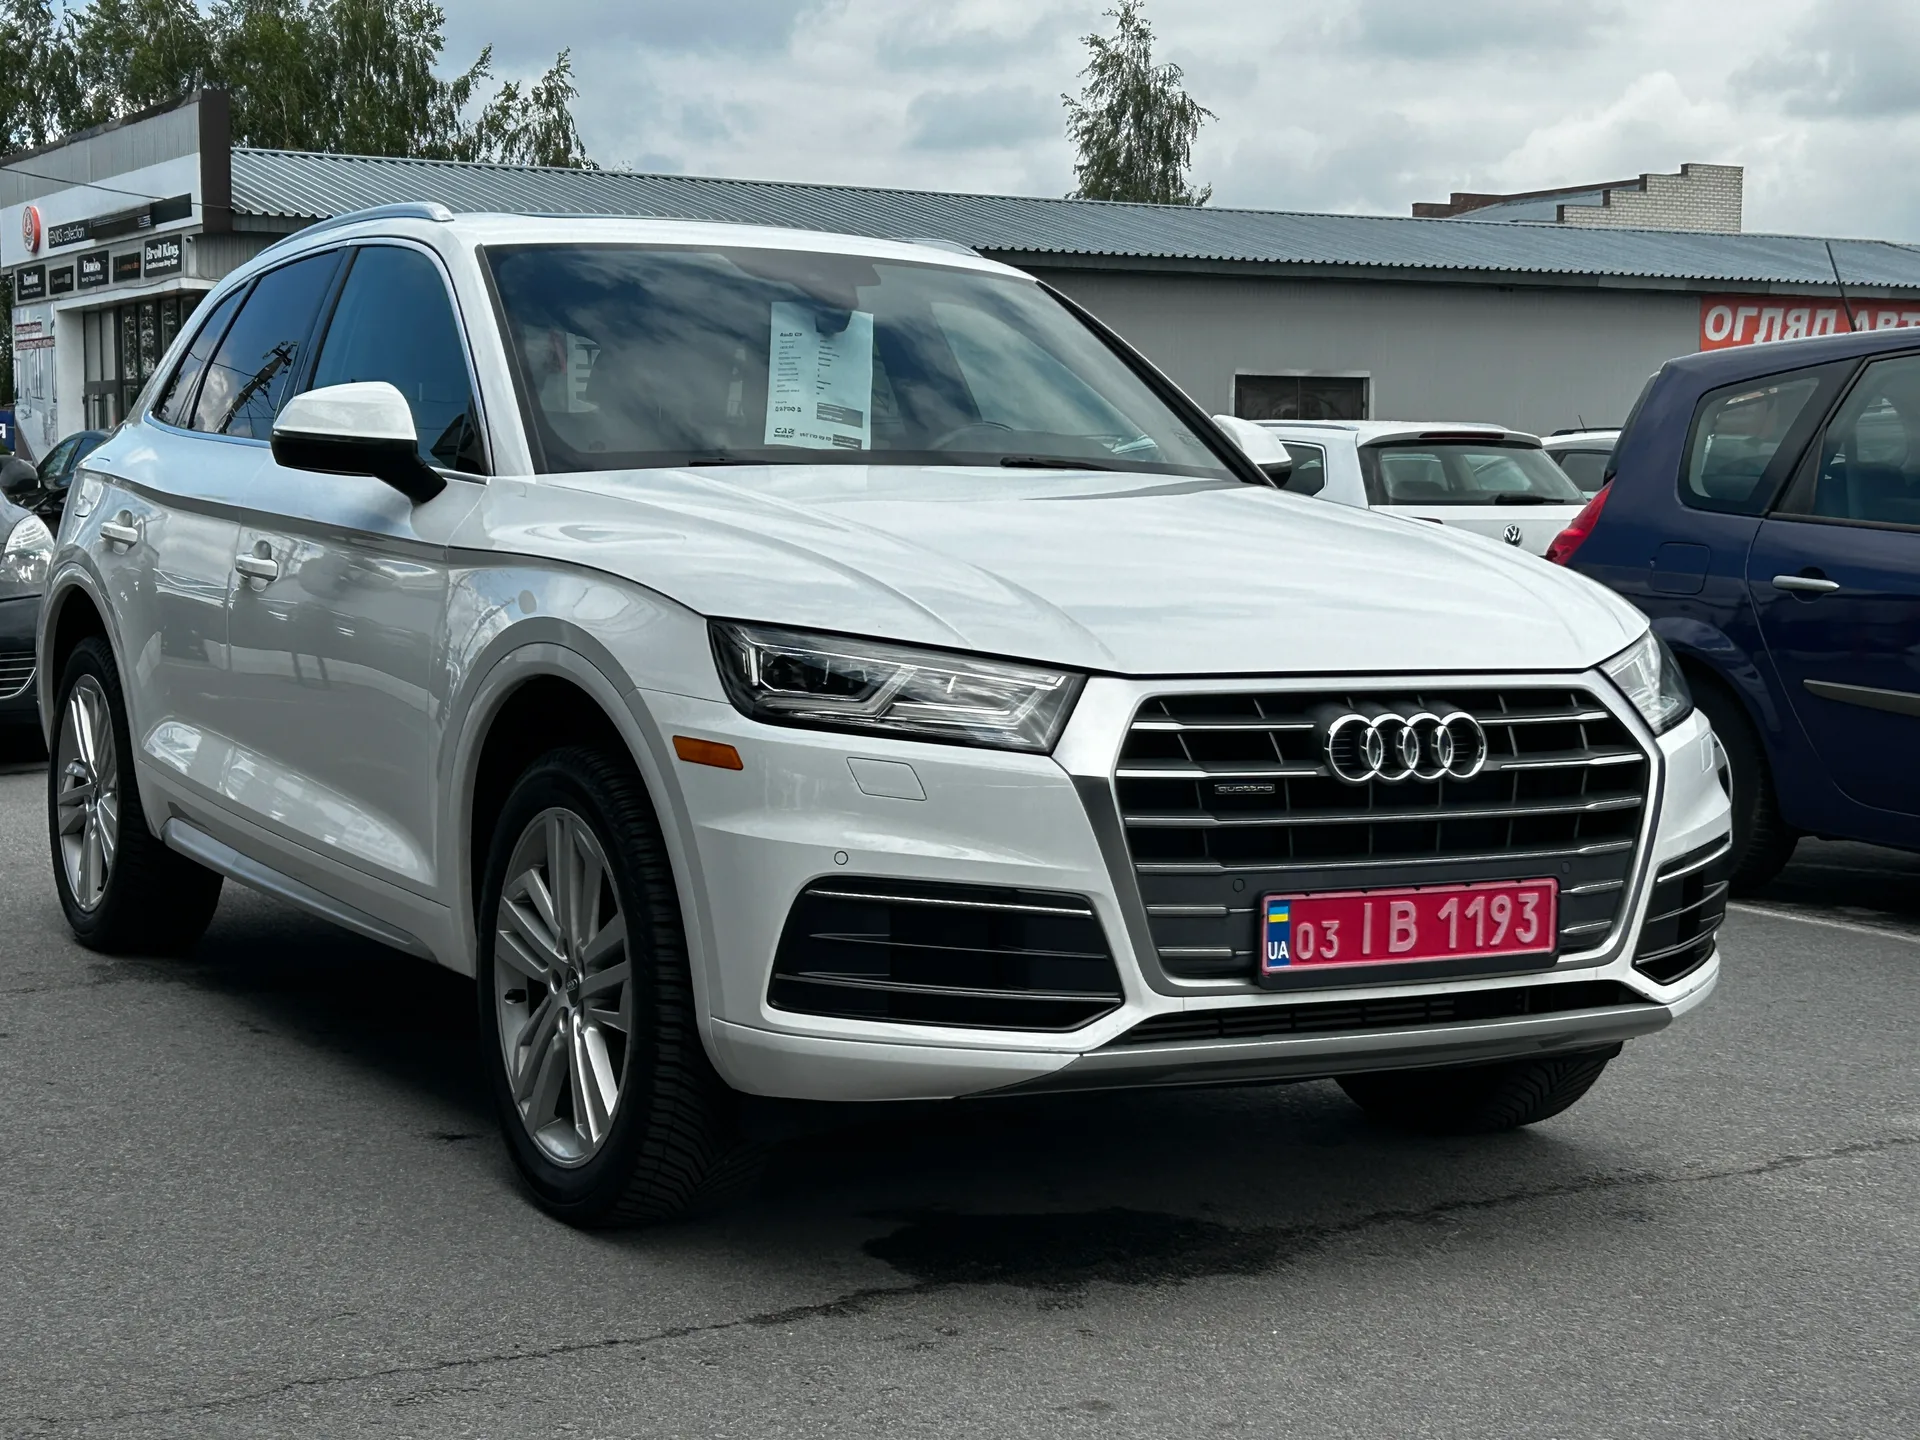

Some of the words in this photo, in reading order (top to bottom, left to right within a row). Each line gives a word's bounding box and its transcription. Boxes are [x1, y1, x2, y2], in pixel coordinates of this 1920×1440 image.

[146, 244, 162, 260] Broil
[1704, 305, 1837, 344] ОГЛЯД
[1218, 785, 1273, 794] quattro
[1295, 920, 1340, 960] 03
[1362, 900, 1418, 954] IB
[1437, 892, 1539, 949] 1193
[1267, 940, 1290, 960] UA
